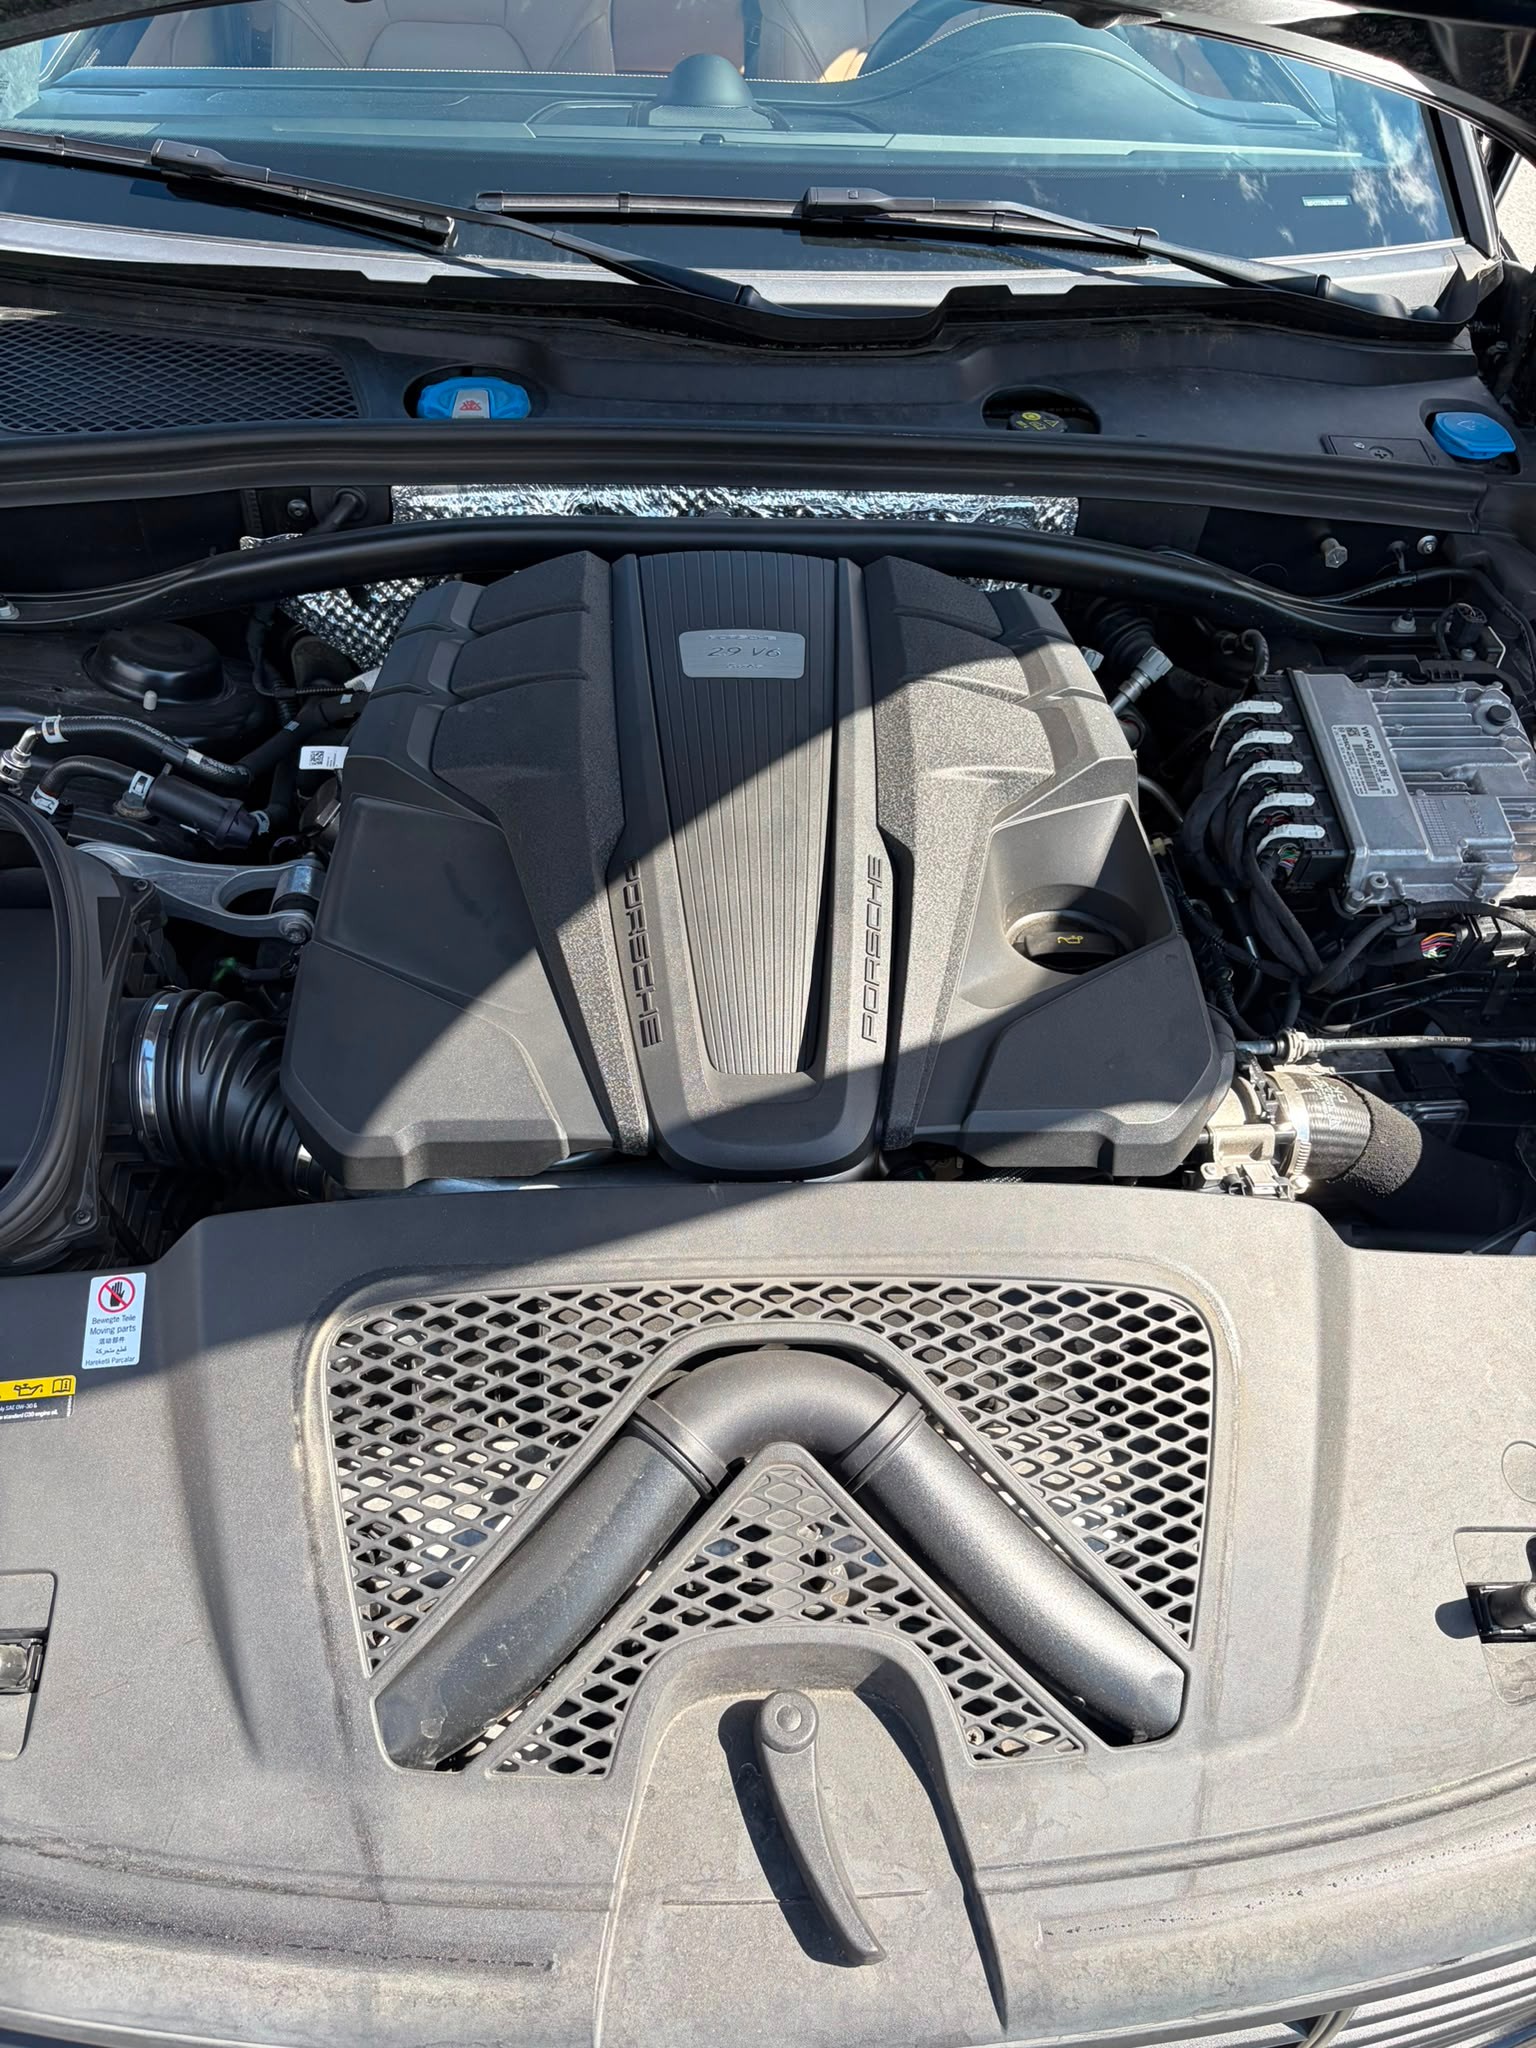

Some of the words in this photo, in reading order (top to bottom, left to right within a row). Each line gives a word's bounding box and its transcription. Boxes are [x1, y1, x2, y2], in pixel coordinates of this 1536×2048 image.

[752, 647, 782, 658] V6
[1360, 726, 1372, 738] VW
[1365, 739, 1375, 749] AG
[623, 859, 663, 1048] PORSCHE
[862, 854, 882, 1043] PORSCHE
[92, 1316, 119, 1325] Bewegte
[122, 1314, 136, 1322] Teile
[90, 1326, 115, 1336] Moving
[117, 1324, 136, 1334] parts
